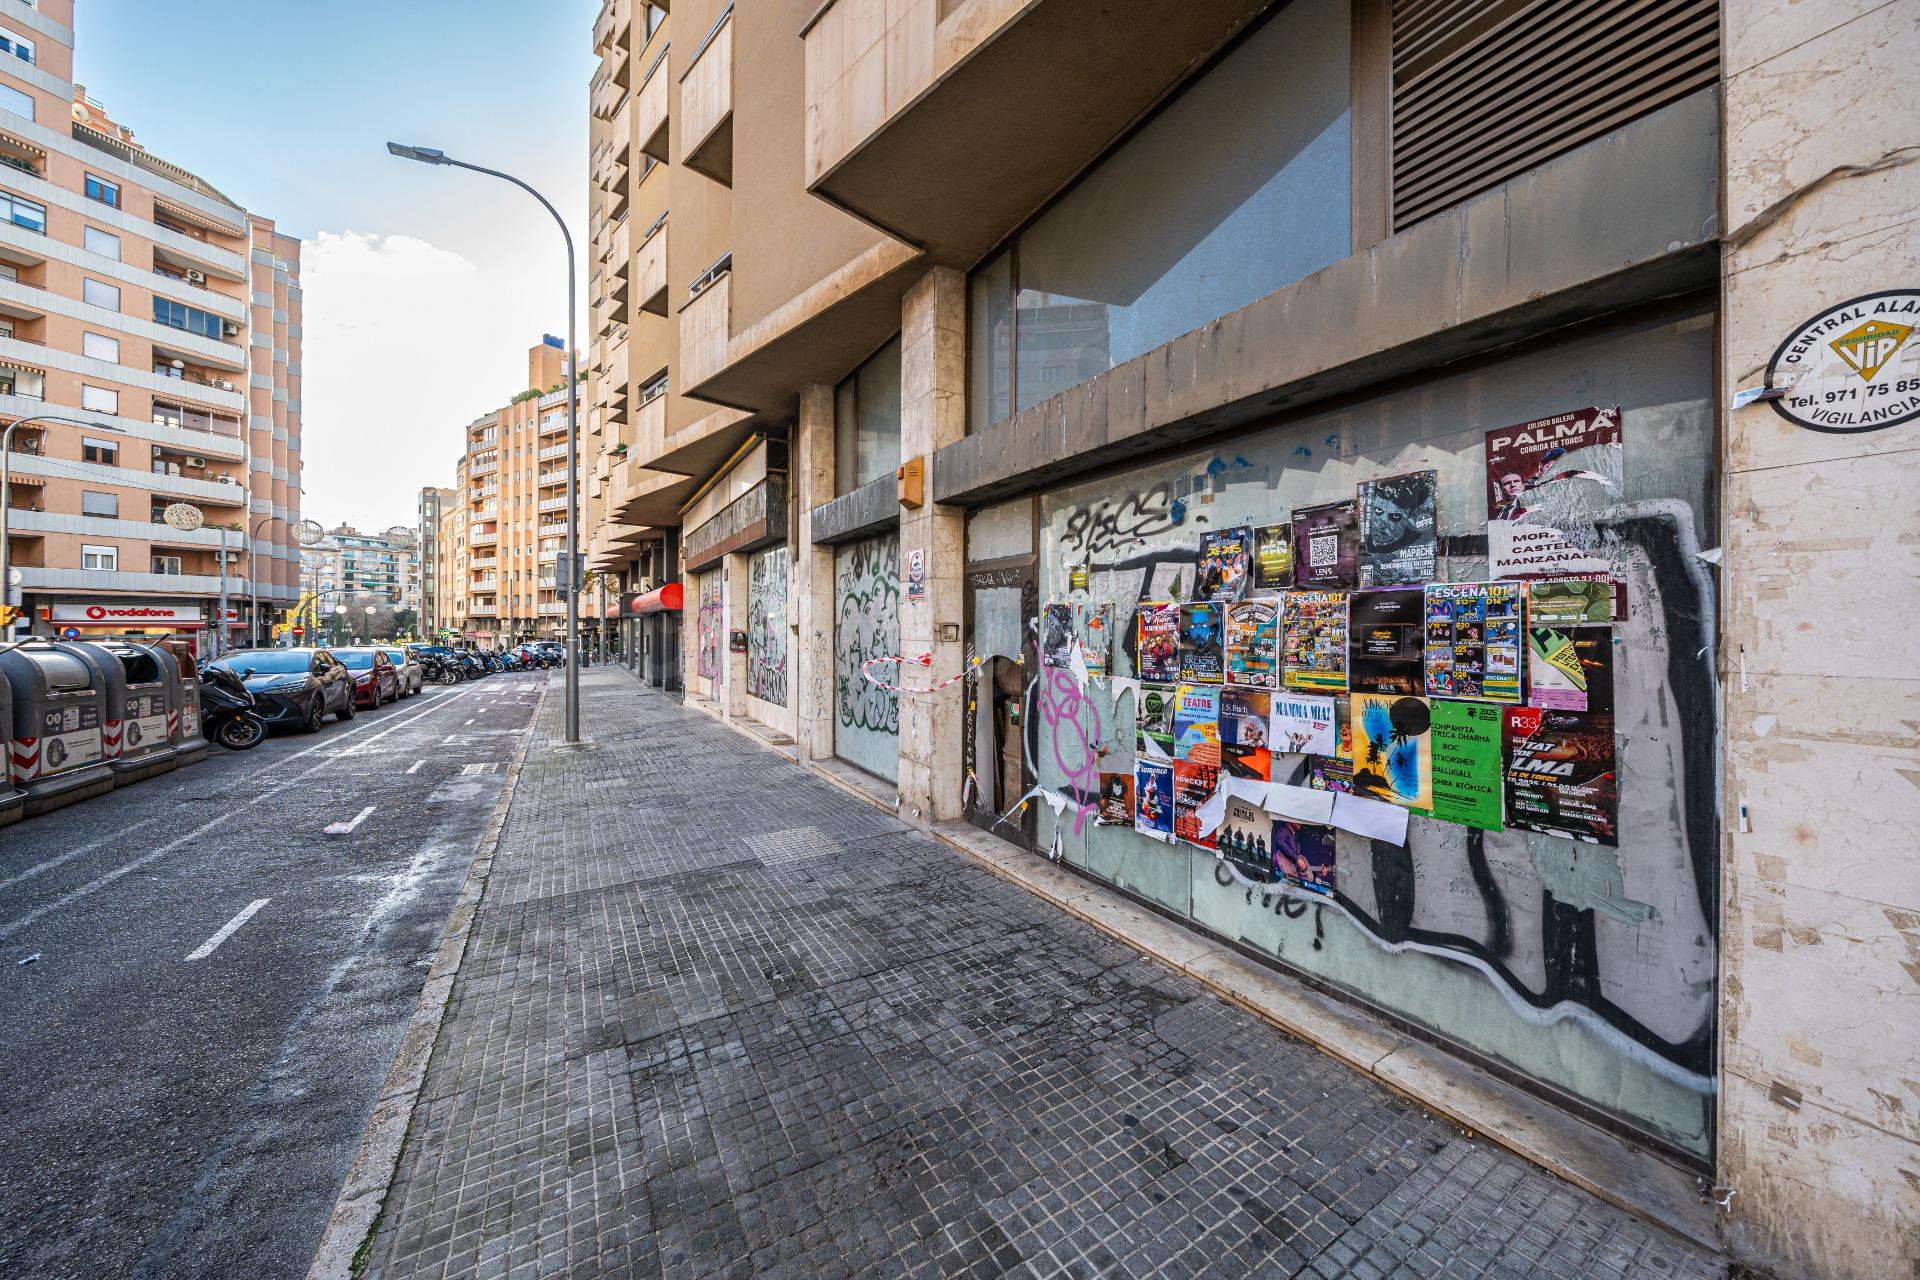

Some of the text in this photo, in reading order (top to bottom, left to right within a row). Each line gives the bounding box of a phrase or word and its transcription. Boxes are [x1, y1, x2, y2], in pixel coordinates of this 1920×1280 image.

[1785, 306, 1866, 363] CENTRAL
[1838, 329, 1899, 346] SEGURIDAD
[1789, 394, 1819, 408] Tel.
[1825, 388, 1857, 403] 971
[1866, 383, 1889, 397] 75
[1527, 413, 1575, 430] COLISEO BALEAR
[1492, 410, 1615, 452] PALMA
[1520, 435, 1584, 455] CORRIDA DE TOROS
[1512, 532, 1555, 542] MOR
[1400, 547, 1435, 559] MAPACHE
[1512, 542, 1573, 554] CASTEL
[1315, 567, 1333, 576] LENS
[107, 608, 175, 617] vodafone
[1183, 698, 1212, 709] TEATRE
[1362, 698, 1394, 710] AMO
[1276, 702, 1331, 721] MAMMA MIA!
[1479, 708, 1497, 716] 2025
[1511, 716, 1538, 729] R33
[1458, 733, 1490, 743] DHARMA
[1442, 743, 1459, 751] BOC
[1511, 757, 1575, 777] LMA
[1531, 773, 1558, 782] TOROS
[1456, 781, 1492, 794] ATÒMICA
